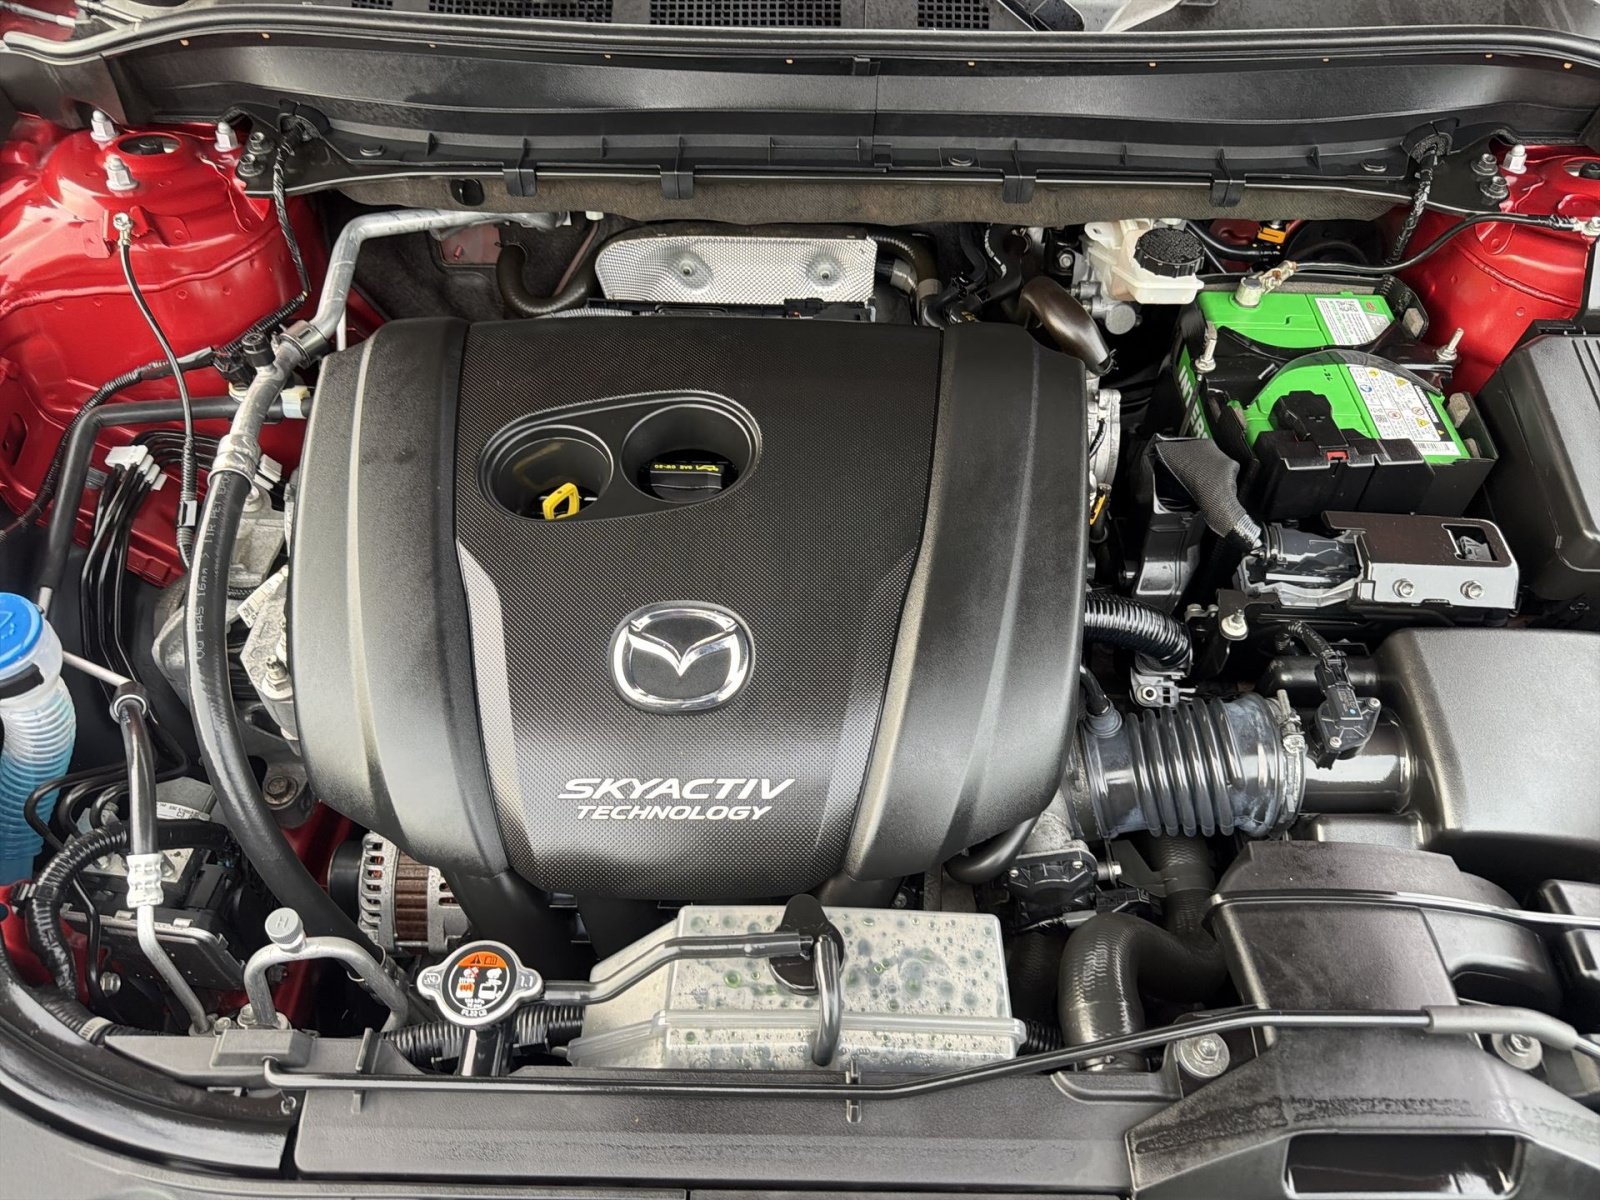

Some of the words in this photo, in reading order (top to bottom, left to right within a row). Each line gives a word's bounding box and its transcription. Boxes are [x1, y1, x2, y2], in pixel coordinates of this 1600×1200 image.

[1178, 365, 1209, 440] INTER
[558, 778, 795, 800] SKYACTIV
[577, 805, 772, 820] TECHNOLOGY
